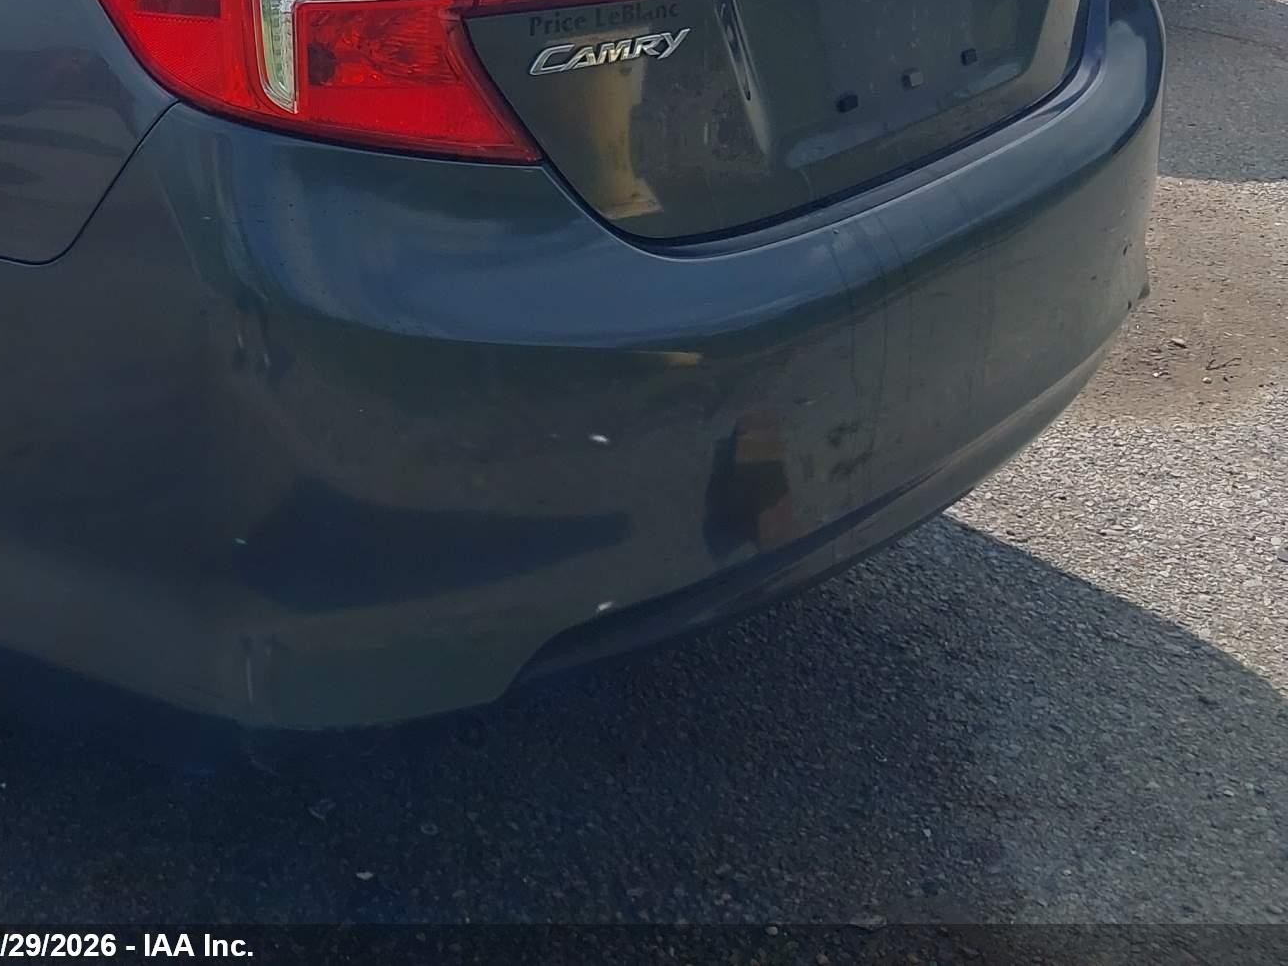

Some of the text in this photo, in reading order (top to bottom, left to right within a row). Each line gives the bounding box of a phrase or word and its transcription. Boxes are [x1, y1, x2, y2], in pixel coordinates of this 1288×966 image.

[529, 3, 680, 36] Price LeBlanc
[529, 27, 691, 76] CAMRY
